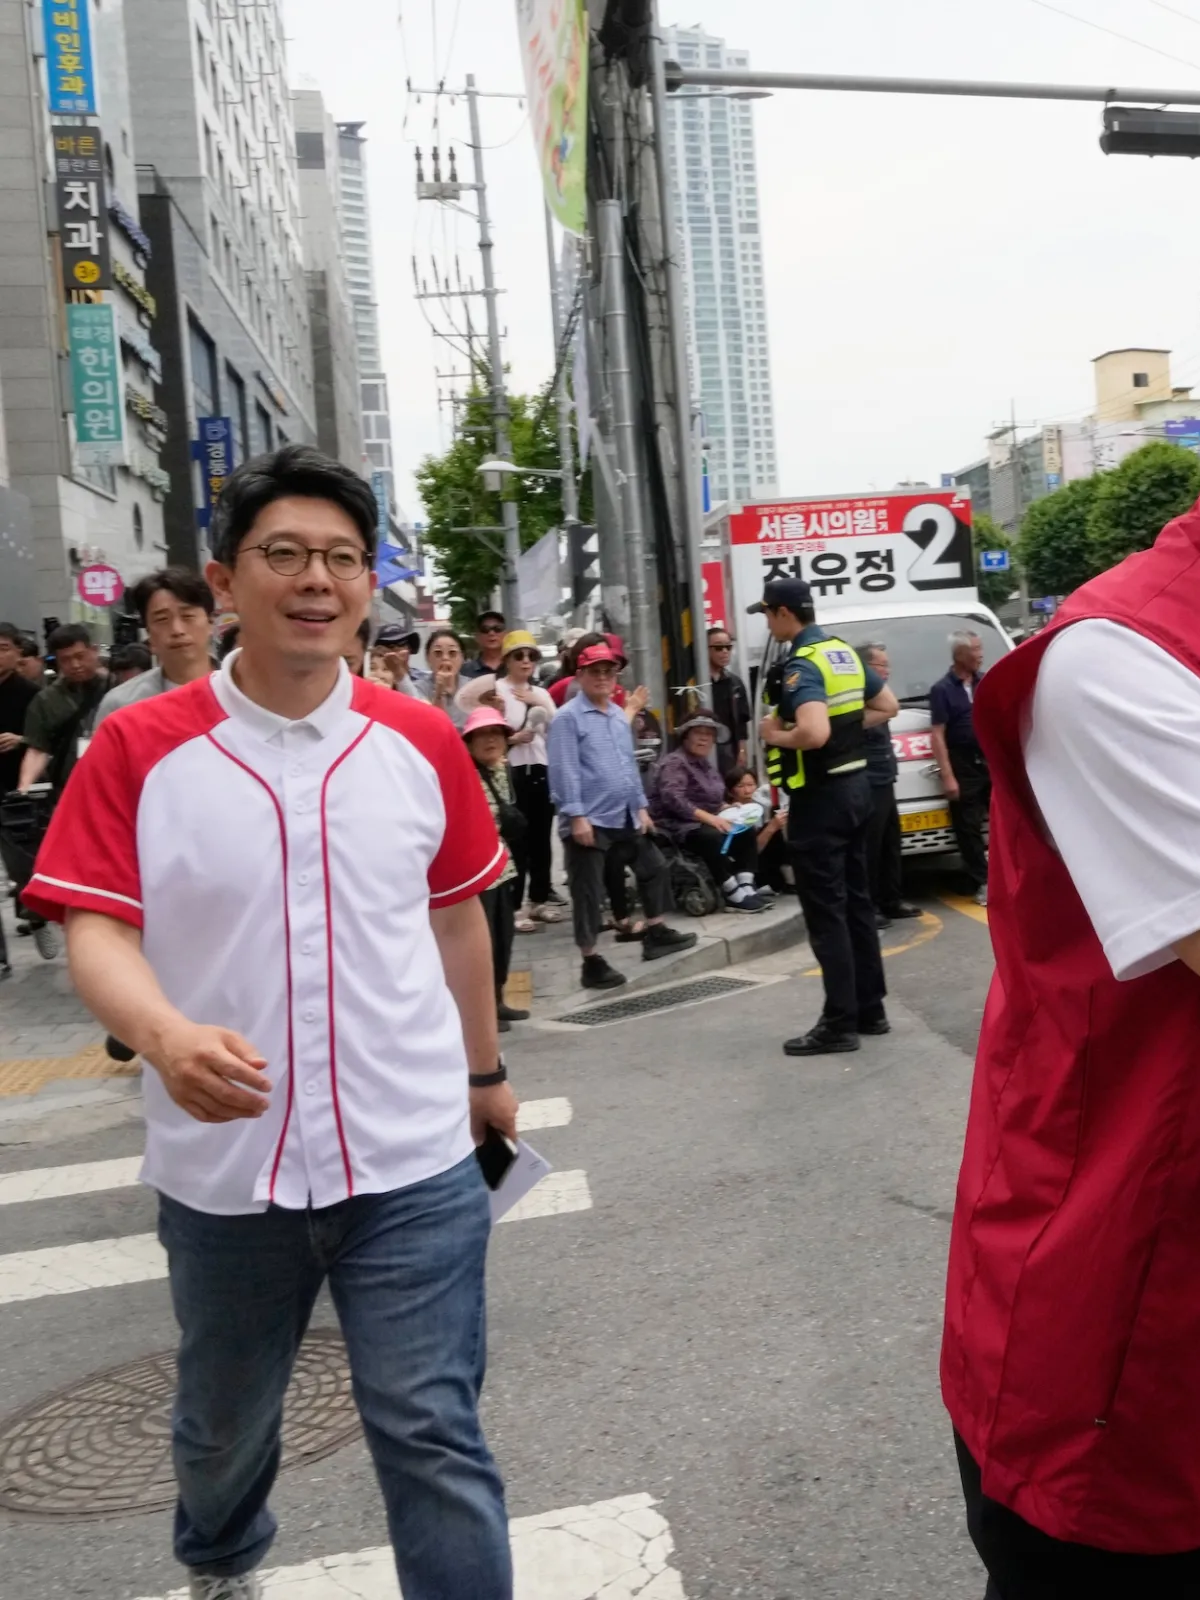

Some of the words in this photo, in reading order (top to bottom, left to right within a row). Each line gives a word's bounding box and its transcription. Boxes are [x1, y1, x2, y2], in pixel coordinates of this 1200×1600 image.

[63, 181, 104, 256] 치과
[76, 346, 117, 440] 한의원
[757, 509, 877, 540] 서울시의원
[902, 503, 962, 582] 2
[83, 571, 118, 601] 약
